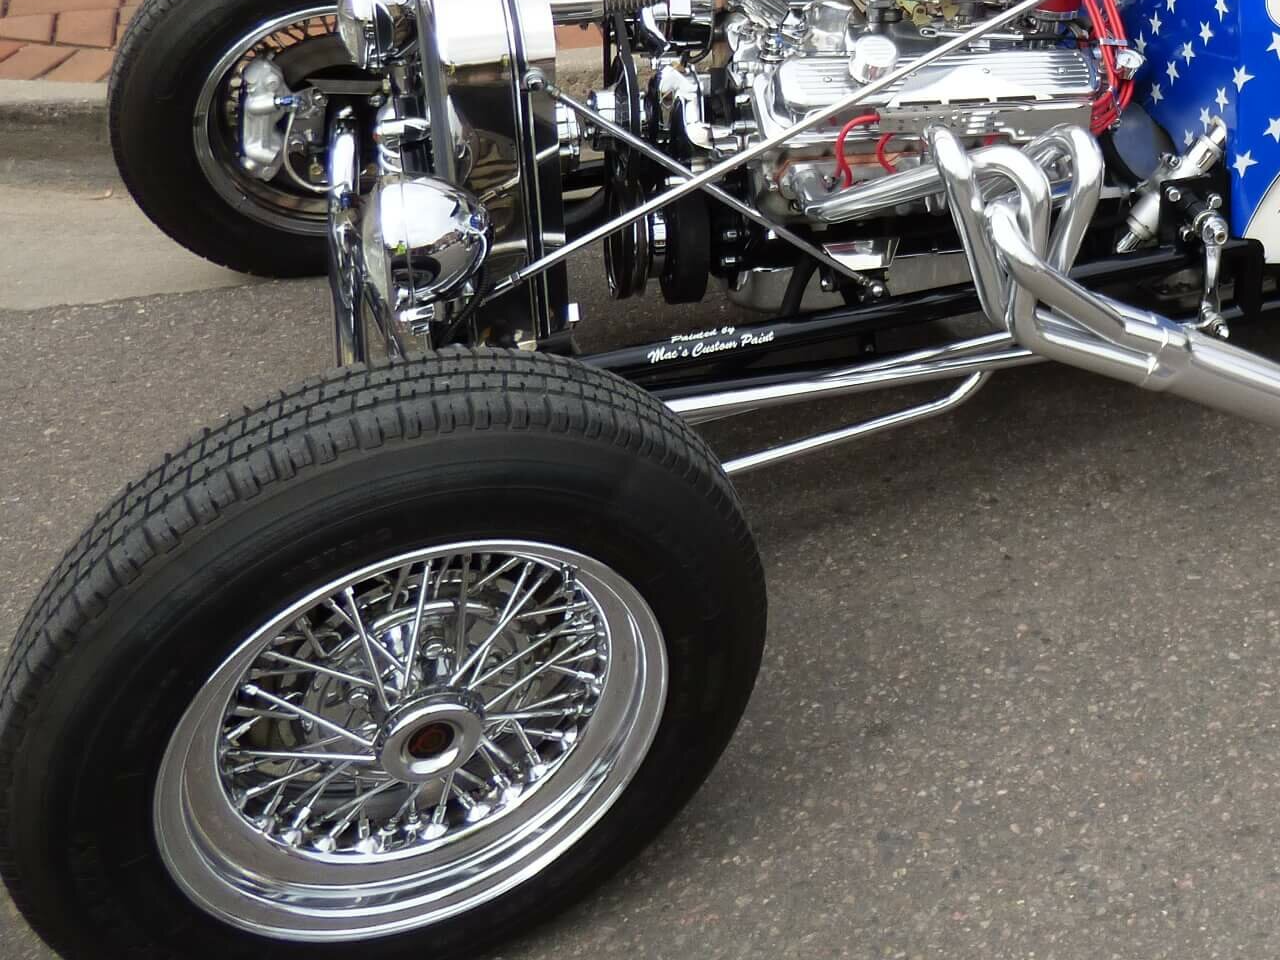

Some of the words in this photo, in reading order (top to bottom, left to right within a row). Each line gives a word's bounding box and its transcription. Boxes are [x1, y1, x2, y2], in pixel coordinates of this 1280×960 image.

[671, 328, 717, 343] Painted
[721, 326, 736, 335] by
[647, 345, 689, 364] Mac's
[692, 338, 738, 357] Custom
[741, 331, 775, 347] Paint
